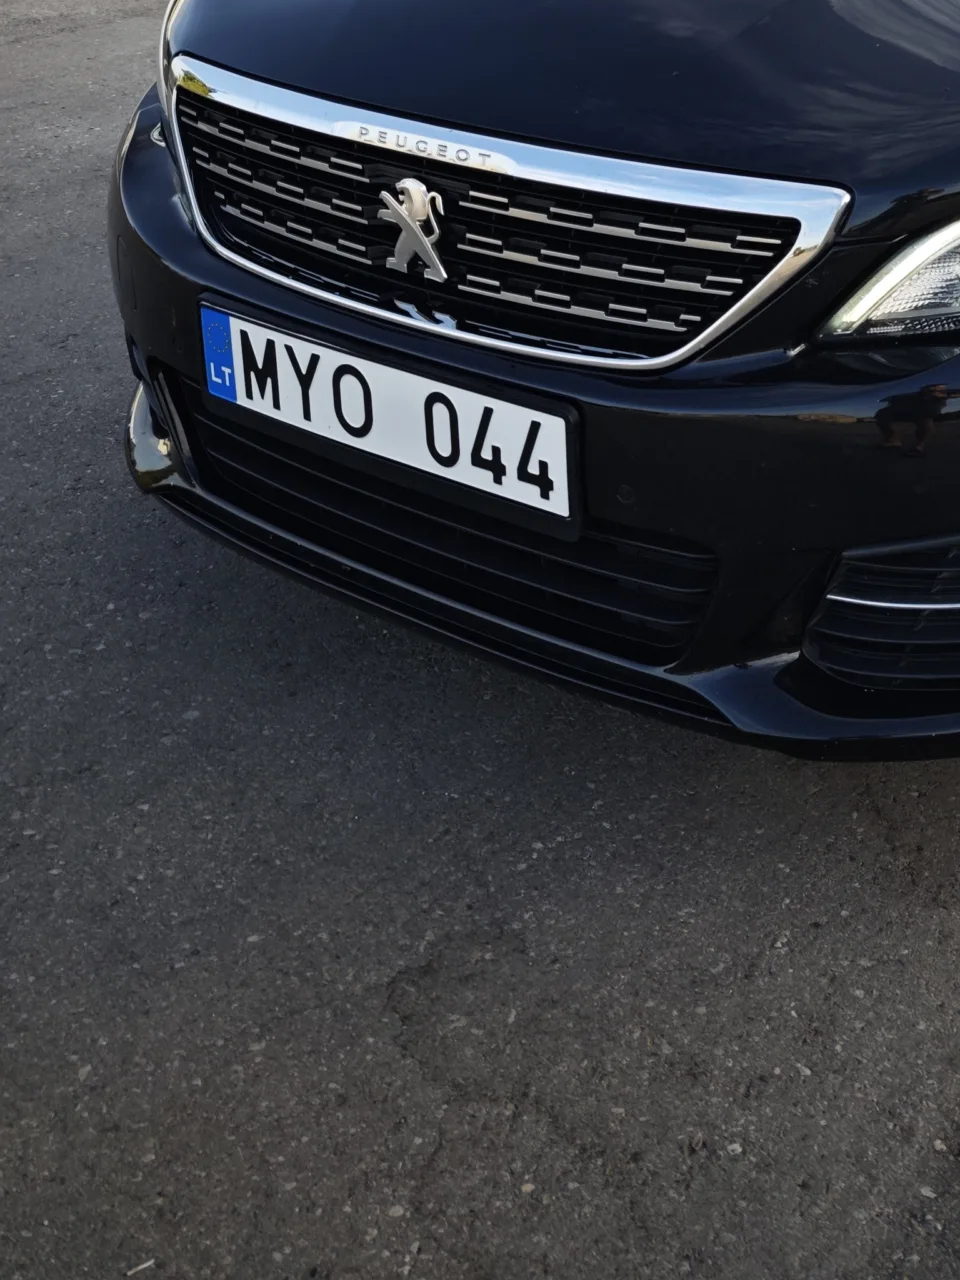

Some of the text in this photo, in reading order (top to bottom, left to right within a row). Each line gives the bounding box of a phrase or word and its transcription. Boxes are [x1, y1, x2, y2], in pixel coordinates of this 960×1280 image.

[359, 126, 491, 166] PEUGEOT
[209, 361, 232, 387] LT
[239, 328, 555, 501] MYO 044
